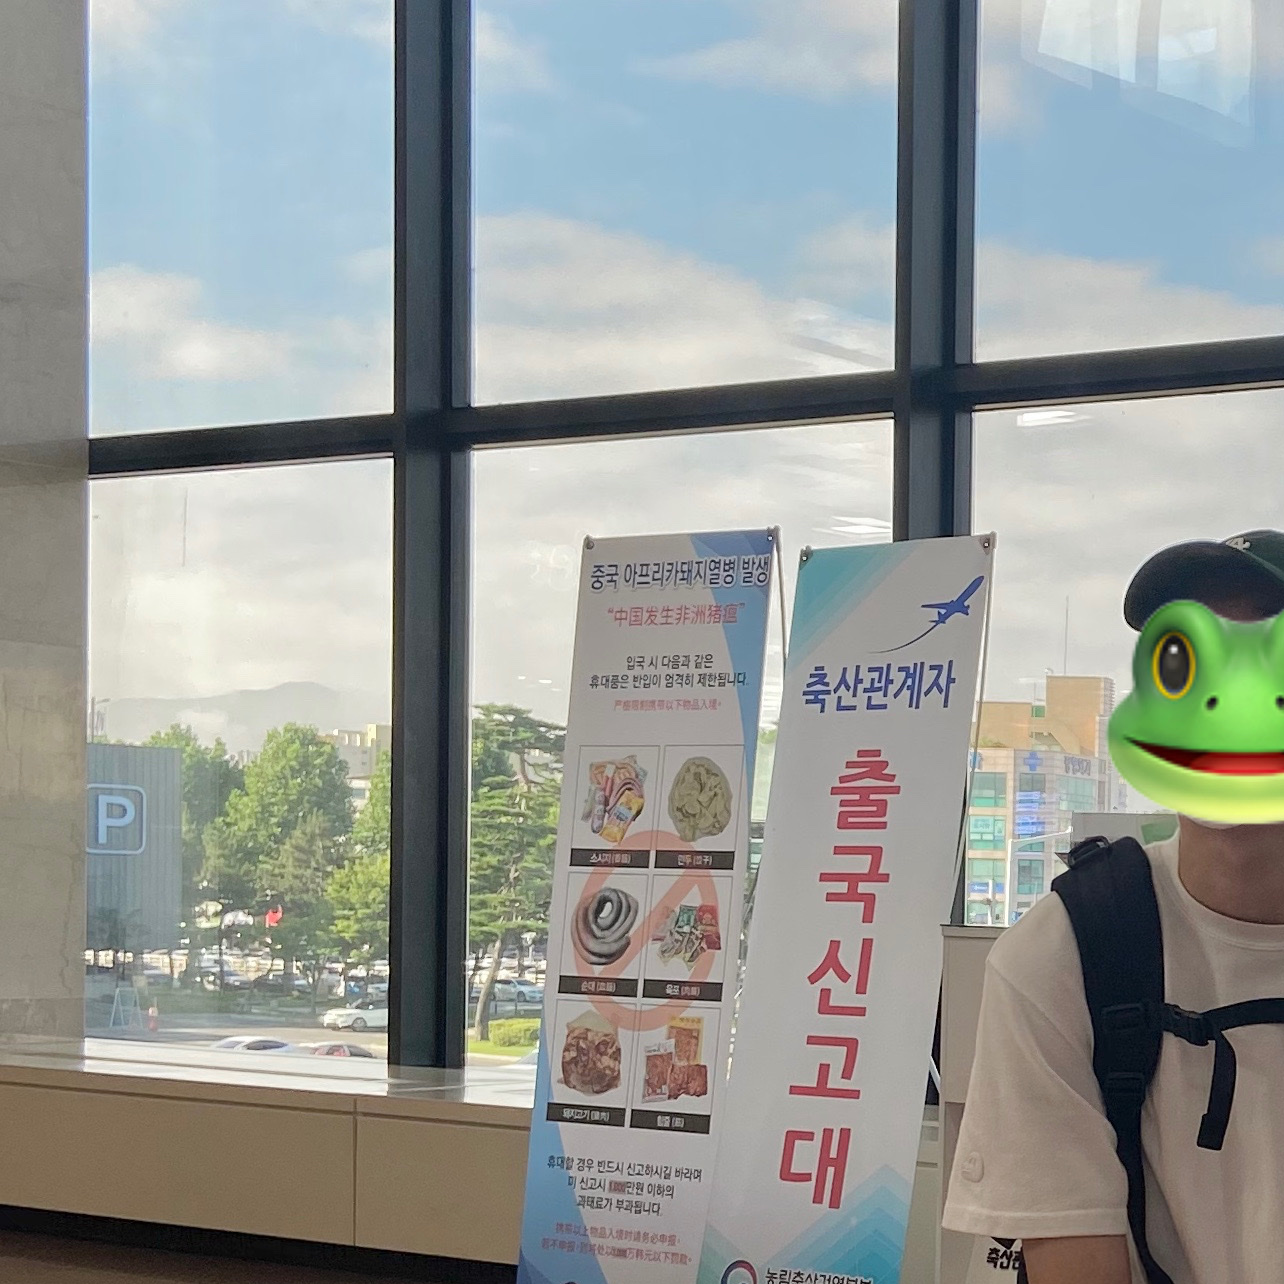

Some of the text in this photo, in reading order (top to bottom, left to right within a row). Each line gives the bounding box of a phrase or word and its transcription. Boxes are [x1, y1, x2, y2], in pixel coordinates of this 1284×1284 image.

[590, 555, 771, 591] 중국 아프리카돼지열병 발생
[626, 653, 714, 671] 입국 시 다음과 같은
[589, 674, 630, 690] 휴대품은
[632, 673, 662, 689] 반입이
[665, 672, 695, 689] 엄격히
[802, 659, 957, 714] 축산관계자
[97, 795, 136, 844] P
[547, 1155, 703, 1183] 휴대할 경우 반드시 신고하시길 바라며
[567, 1175, 577, 1190] 미
[579, 1176, 607, 1193] 신고시
[647, 1183, 675, 1199] 이하의
[577, 1194, 613, 1212] 과태료가
